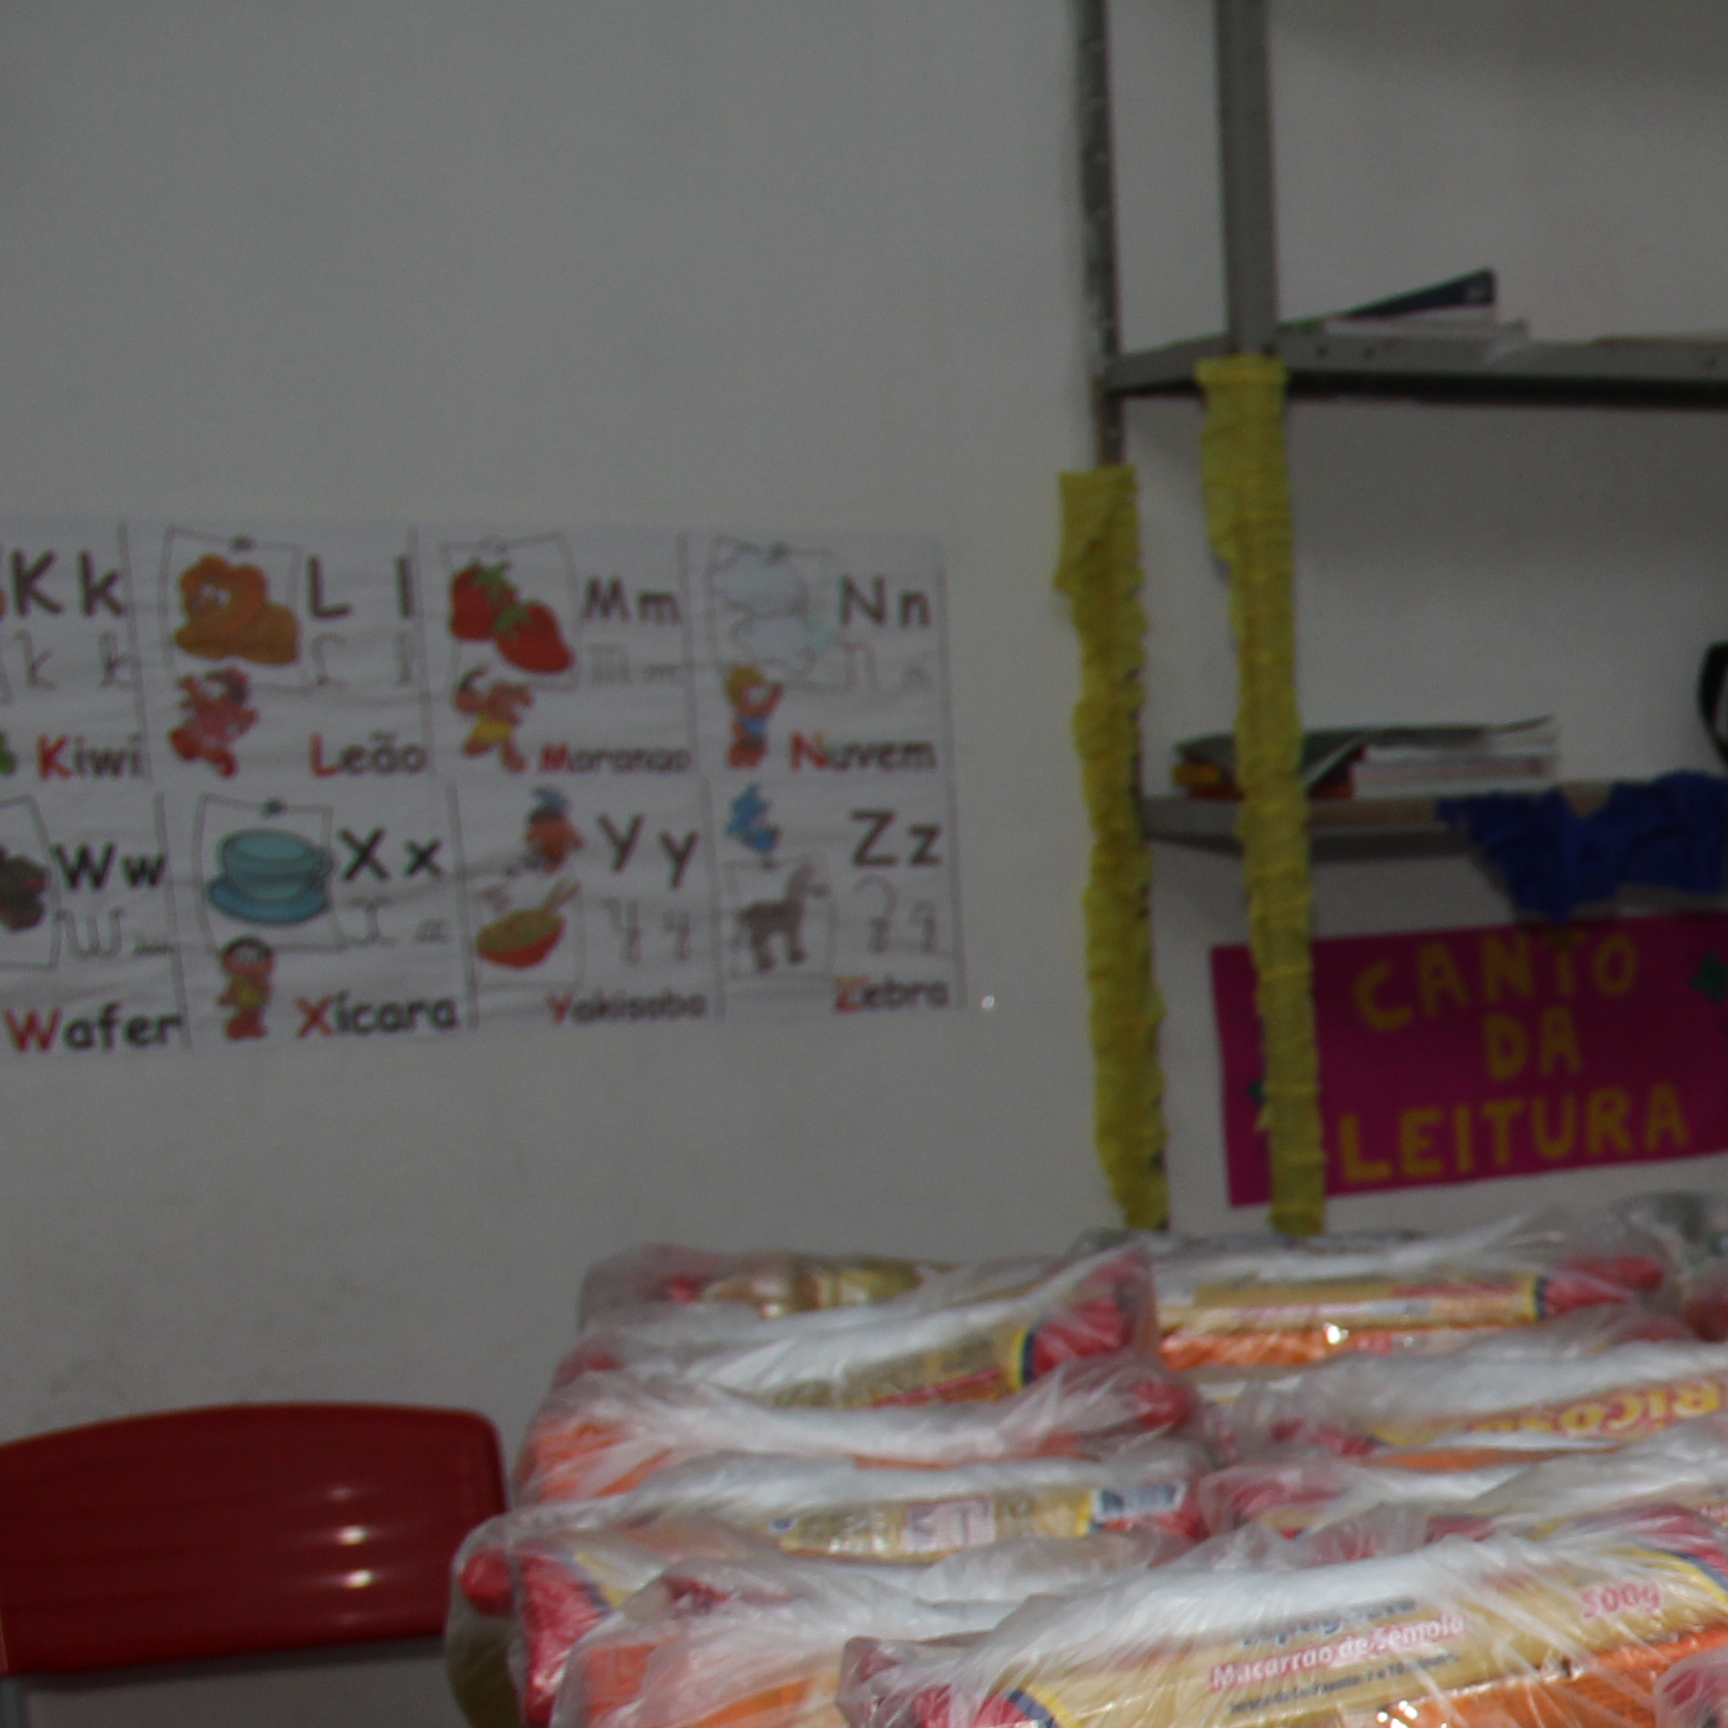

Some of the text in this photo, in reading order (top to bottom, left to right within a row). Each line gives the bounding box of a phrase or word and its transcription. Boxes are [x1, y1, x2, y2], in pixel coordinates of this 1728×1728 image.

[37, 733, 144, 780] Kiwi
[309, 730, 428, 778] Leão
[790, 731, 938, 772] Nuvem
[833, 975, 949, 1013] Zebra
[1351, 930, 1640, 1033] CANTO
[4, 1002, 184, 1052] Wafer
[296, 988, 458, 1039] Xícara
[1482, 1006, 1585, 1082] DA
[1339, 1083, 1691, 1183] LEITURA
[1580, 1583, 1663, 1619] 500g
